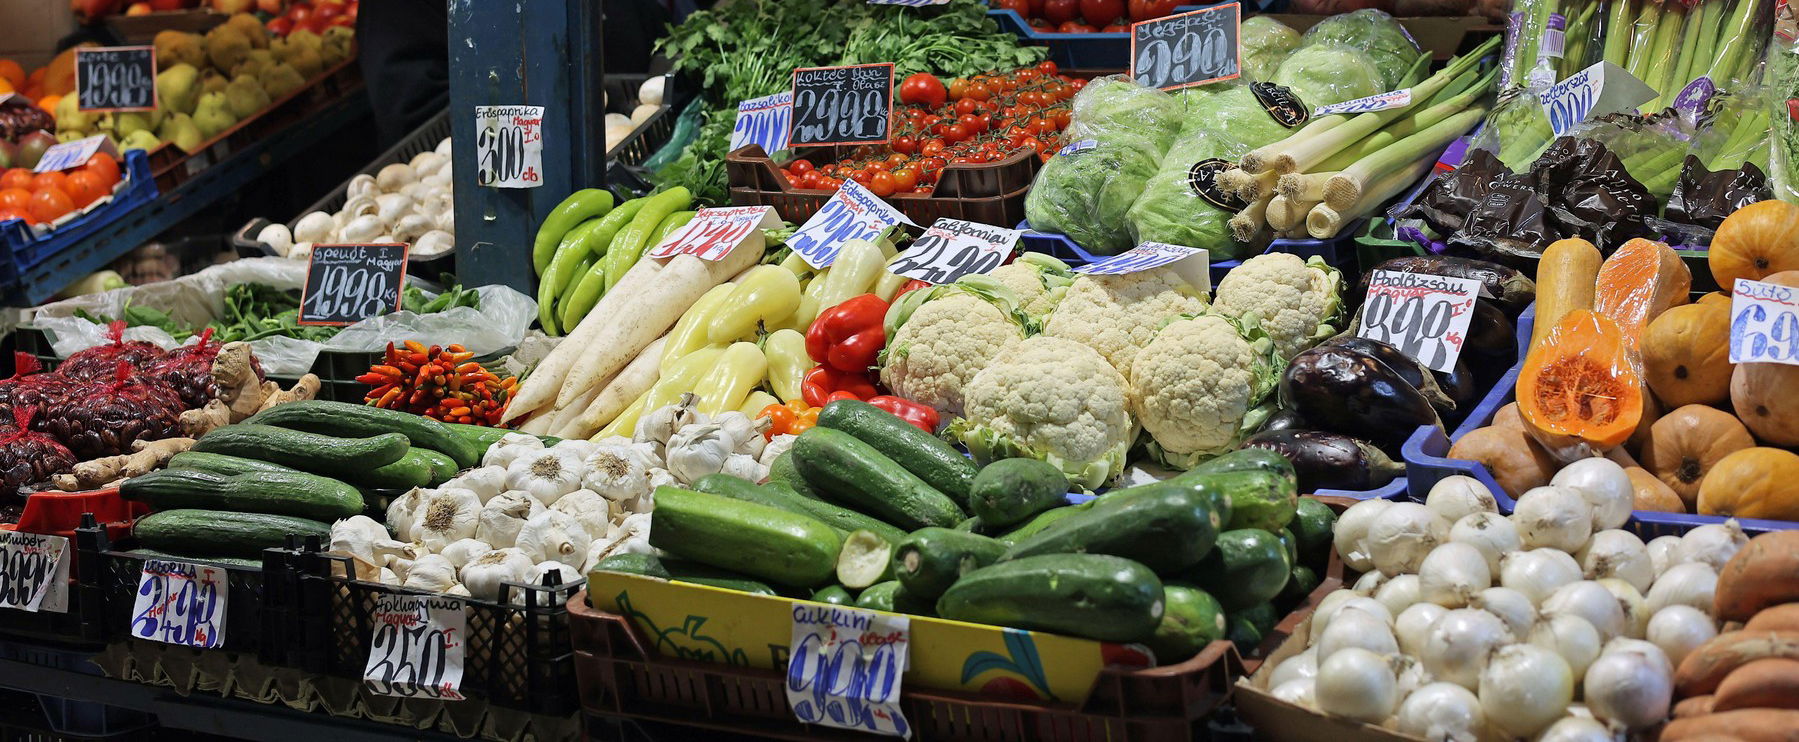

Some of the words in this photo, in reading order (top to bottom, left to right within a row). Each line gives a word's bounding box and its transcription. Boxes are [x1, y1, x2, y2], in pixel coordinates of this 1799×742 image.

[1135, 29, 1228, 88] 990
[513, 116, 543, 133] Magyar
[479, 126, 525, 185] 300
[303, 265, 388, 320] 1998
[366, 257, 404, 272] Magyar
[1730, 304, 1799, 361] 69
[362, 624, 446, 698] 350
